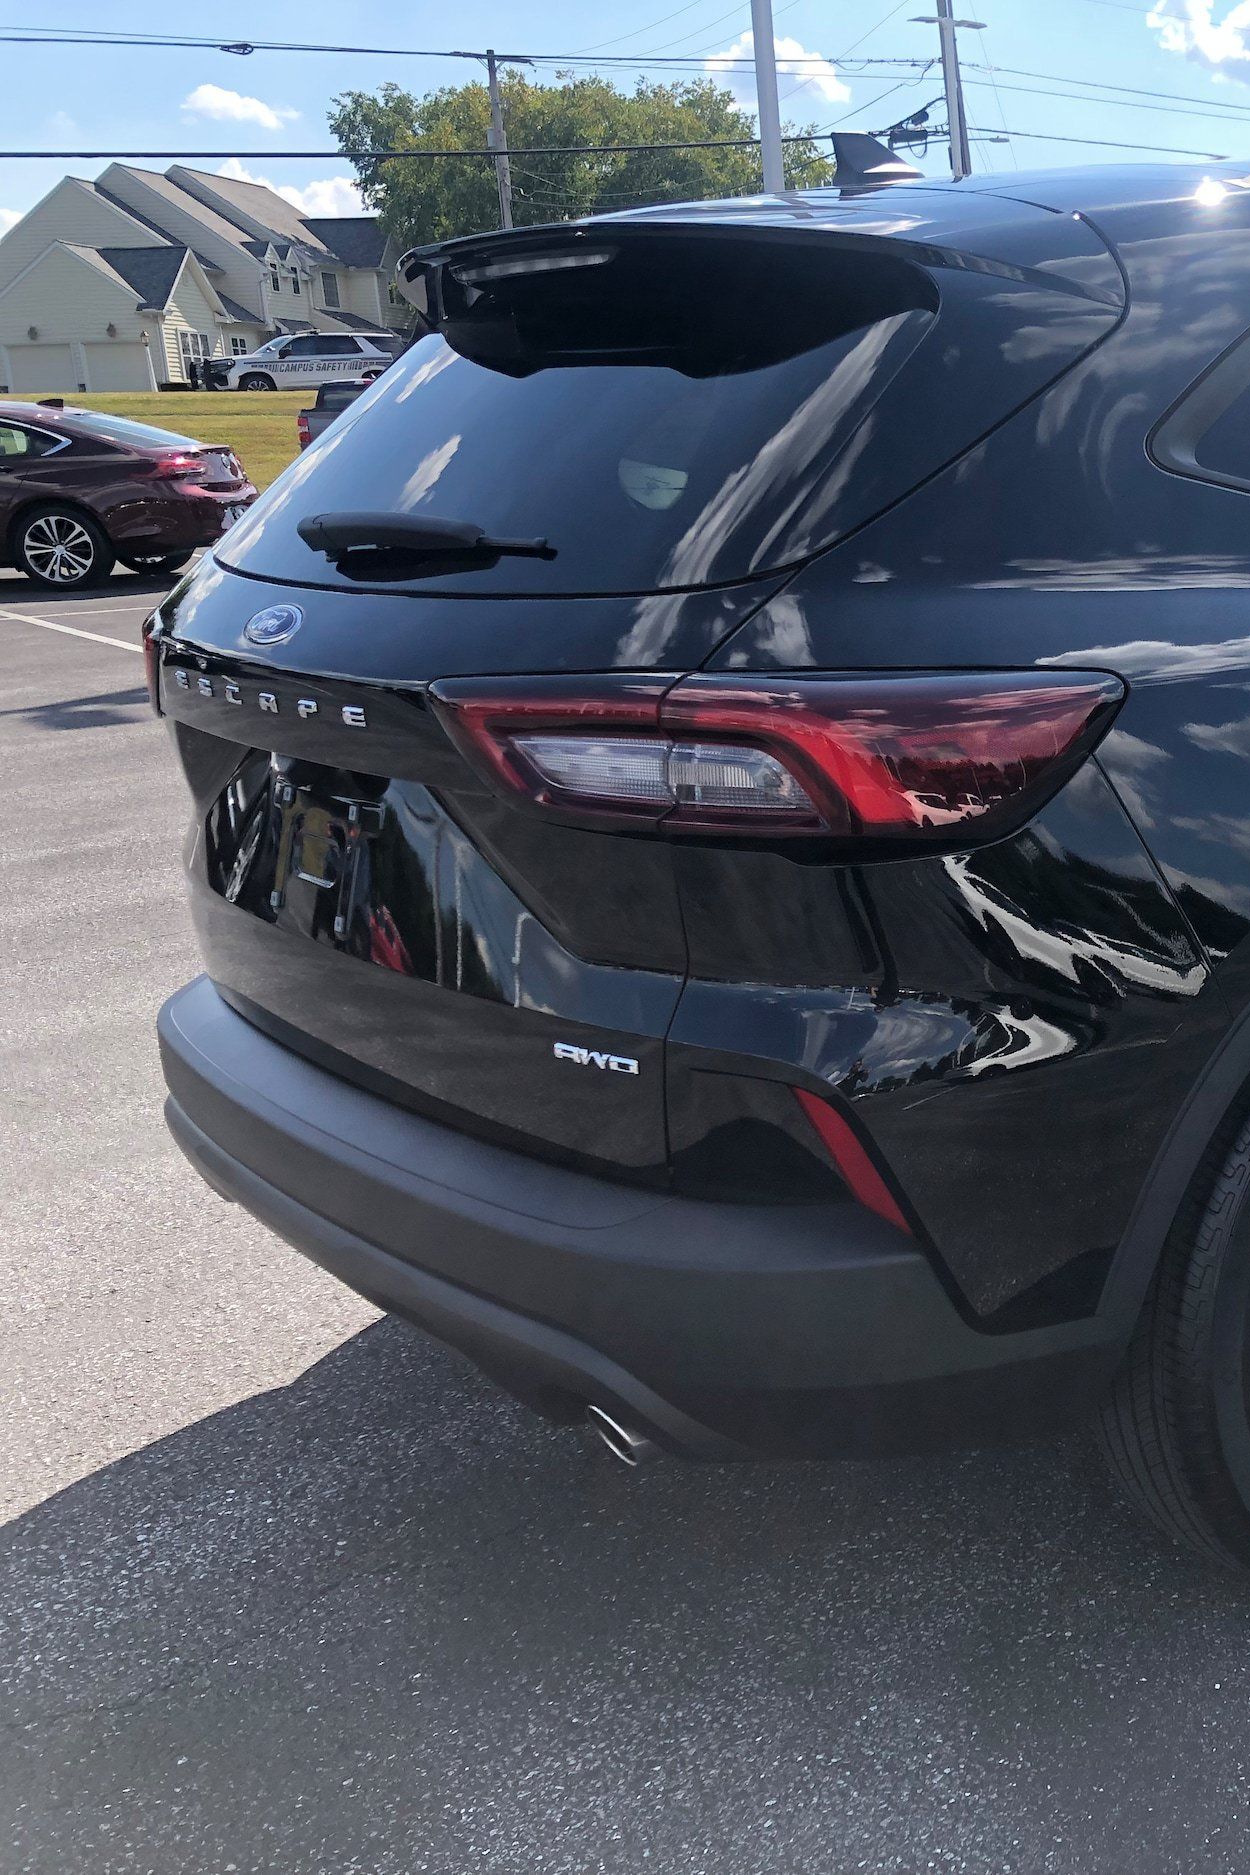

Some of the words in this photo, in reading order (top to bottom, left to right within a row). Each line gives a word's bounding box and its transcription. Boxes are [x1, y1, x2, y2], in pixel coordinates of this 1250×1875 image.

[280, 362, 315, 373] CAMPUS
[315, 361, 349, 372] SAFETY
[251, 610, 288, 632] Ford
[174, 670, 367, 728] ESCAPE
[553, 1042, 640, 1075] AWD
